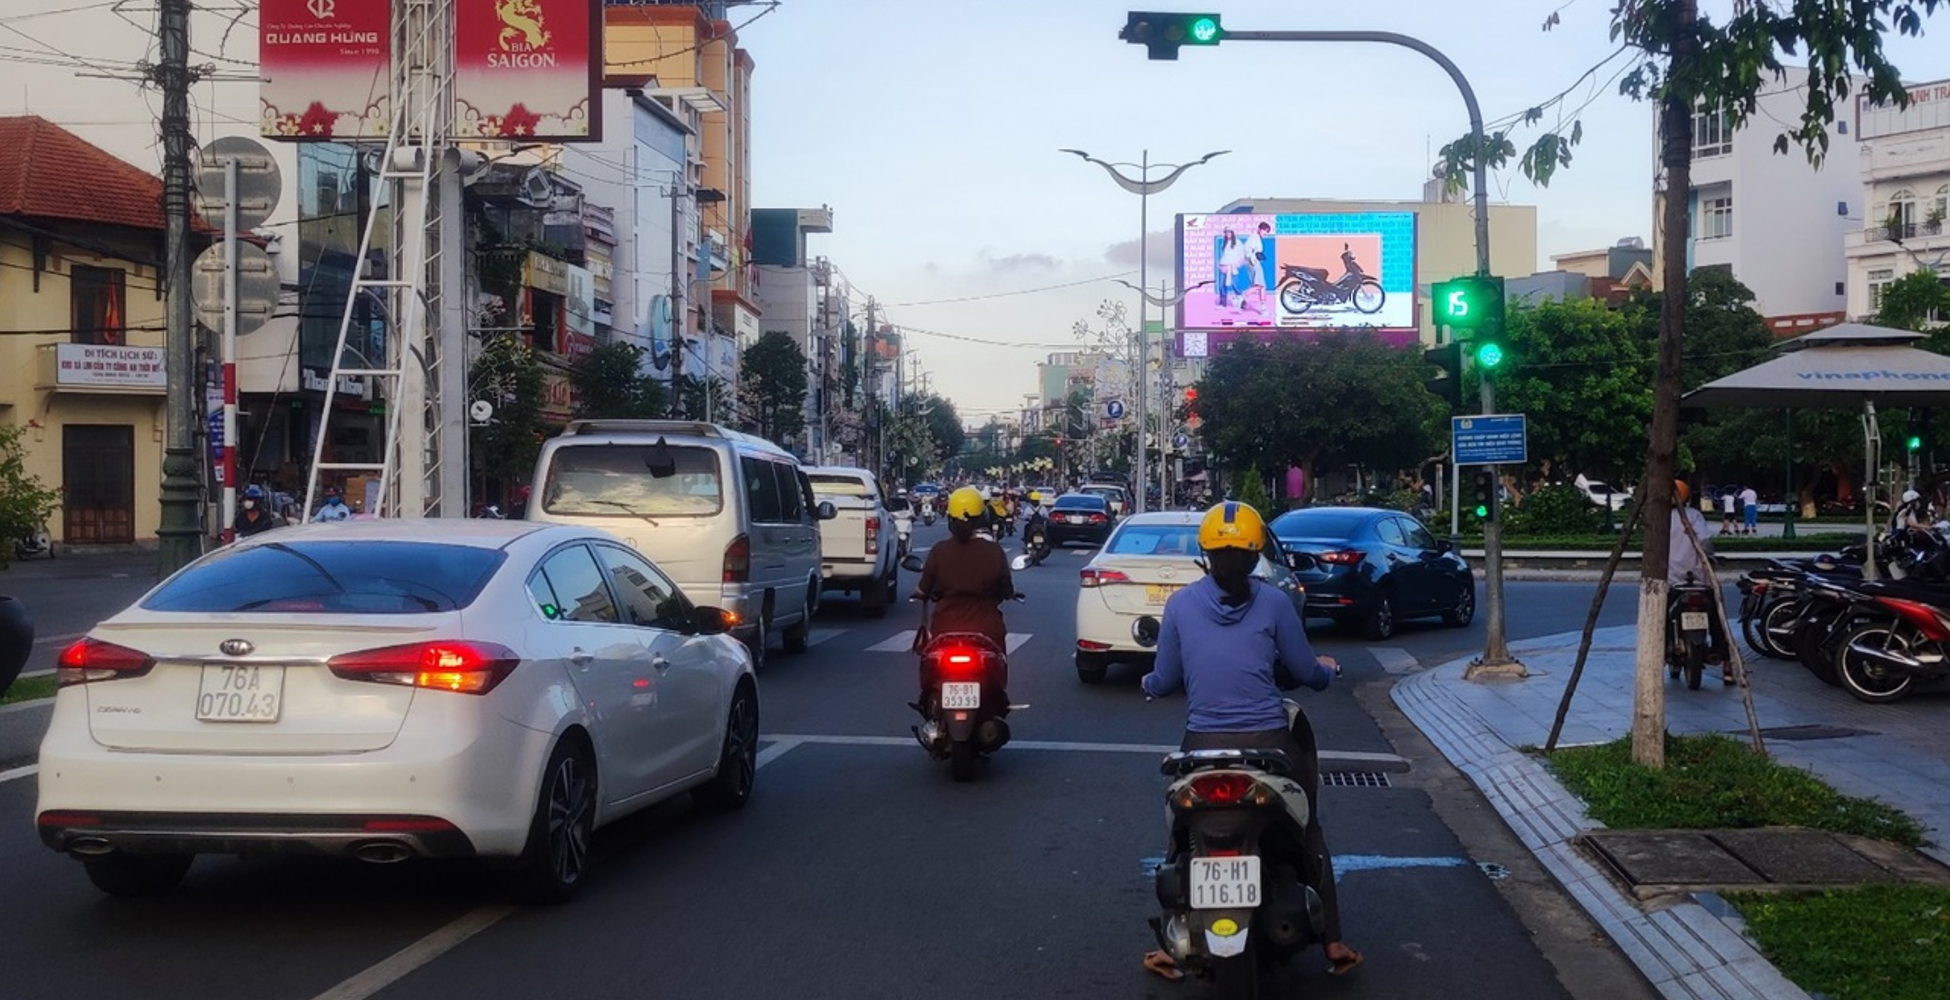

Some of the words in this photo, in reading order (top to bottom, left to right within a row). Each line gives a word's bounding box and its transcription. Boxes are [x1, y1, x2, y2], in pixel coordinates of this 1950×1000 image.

[266, 33, 327, 44] QUANG
[511, 42, 532, 52] BIA
[340, 47, 359, 55] Since
[487, 53, 556, 68] SAIGON
[1448, 290, 1468, 316] 15
[223, 640, 250, 654] KIA
[220, 666, 260, 691] 76A
[199, 693, 276, 717] 070.43
[1201, 860, 1249, 881] 76-H1
[1197, 883, 1256, 905] 116.18
